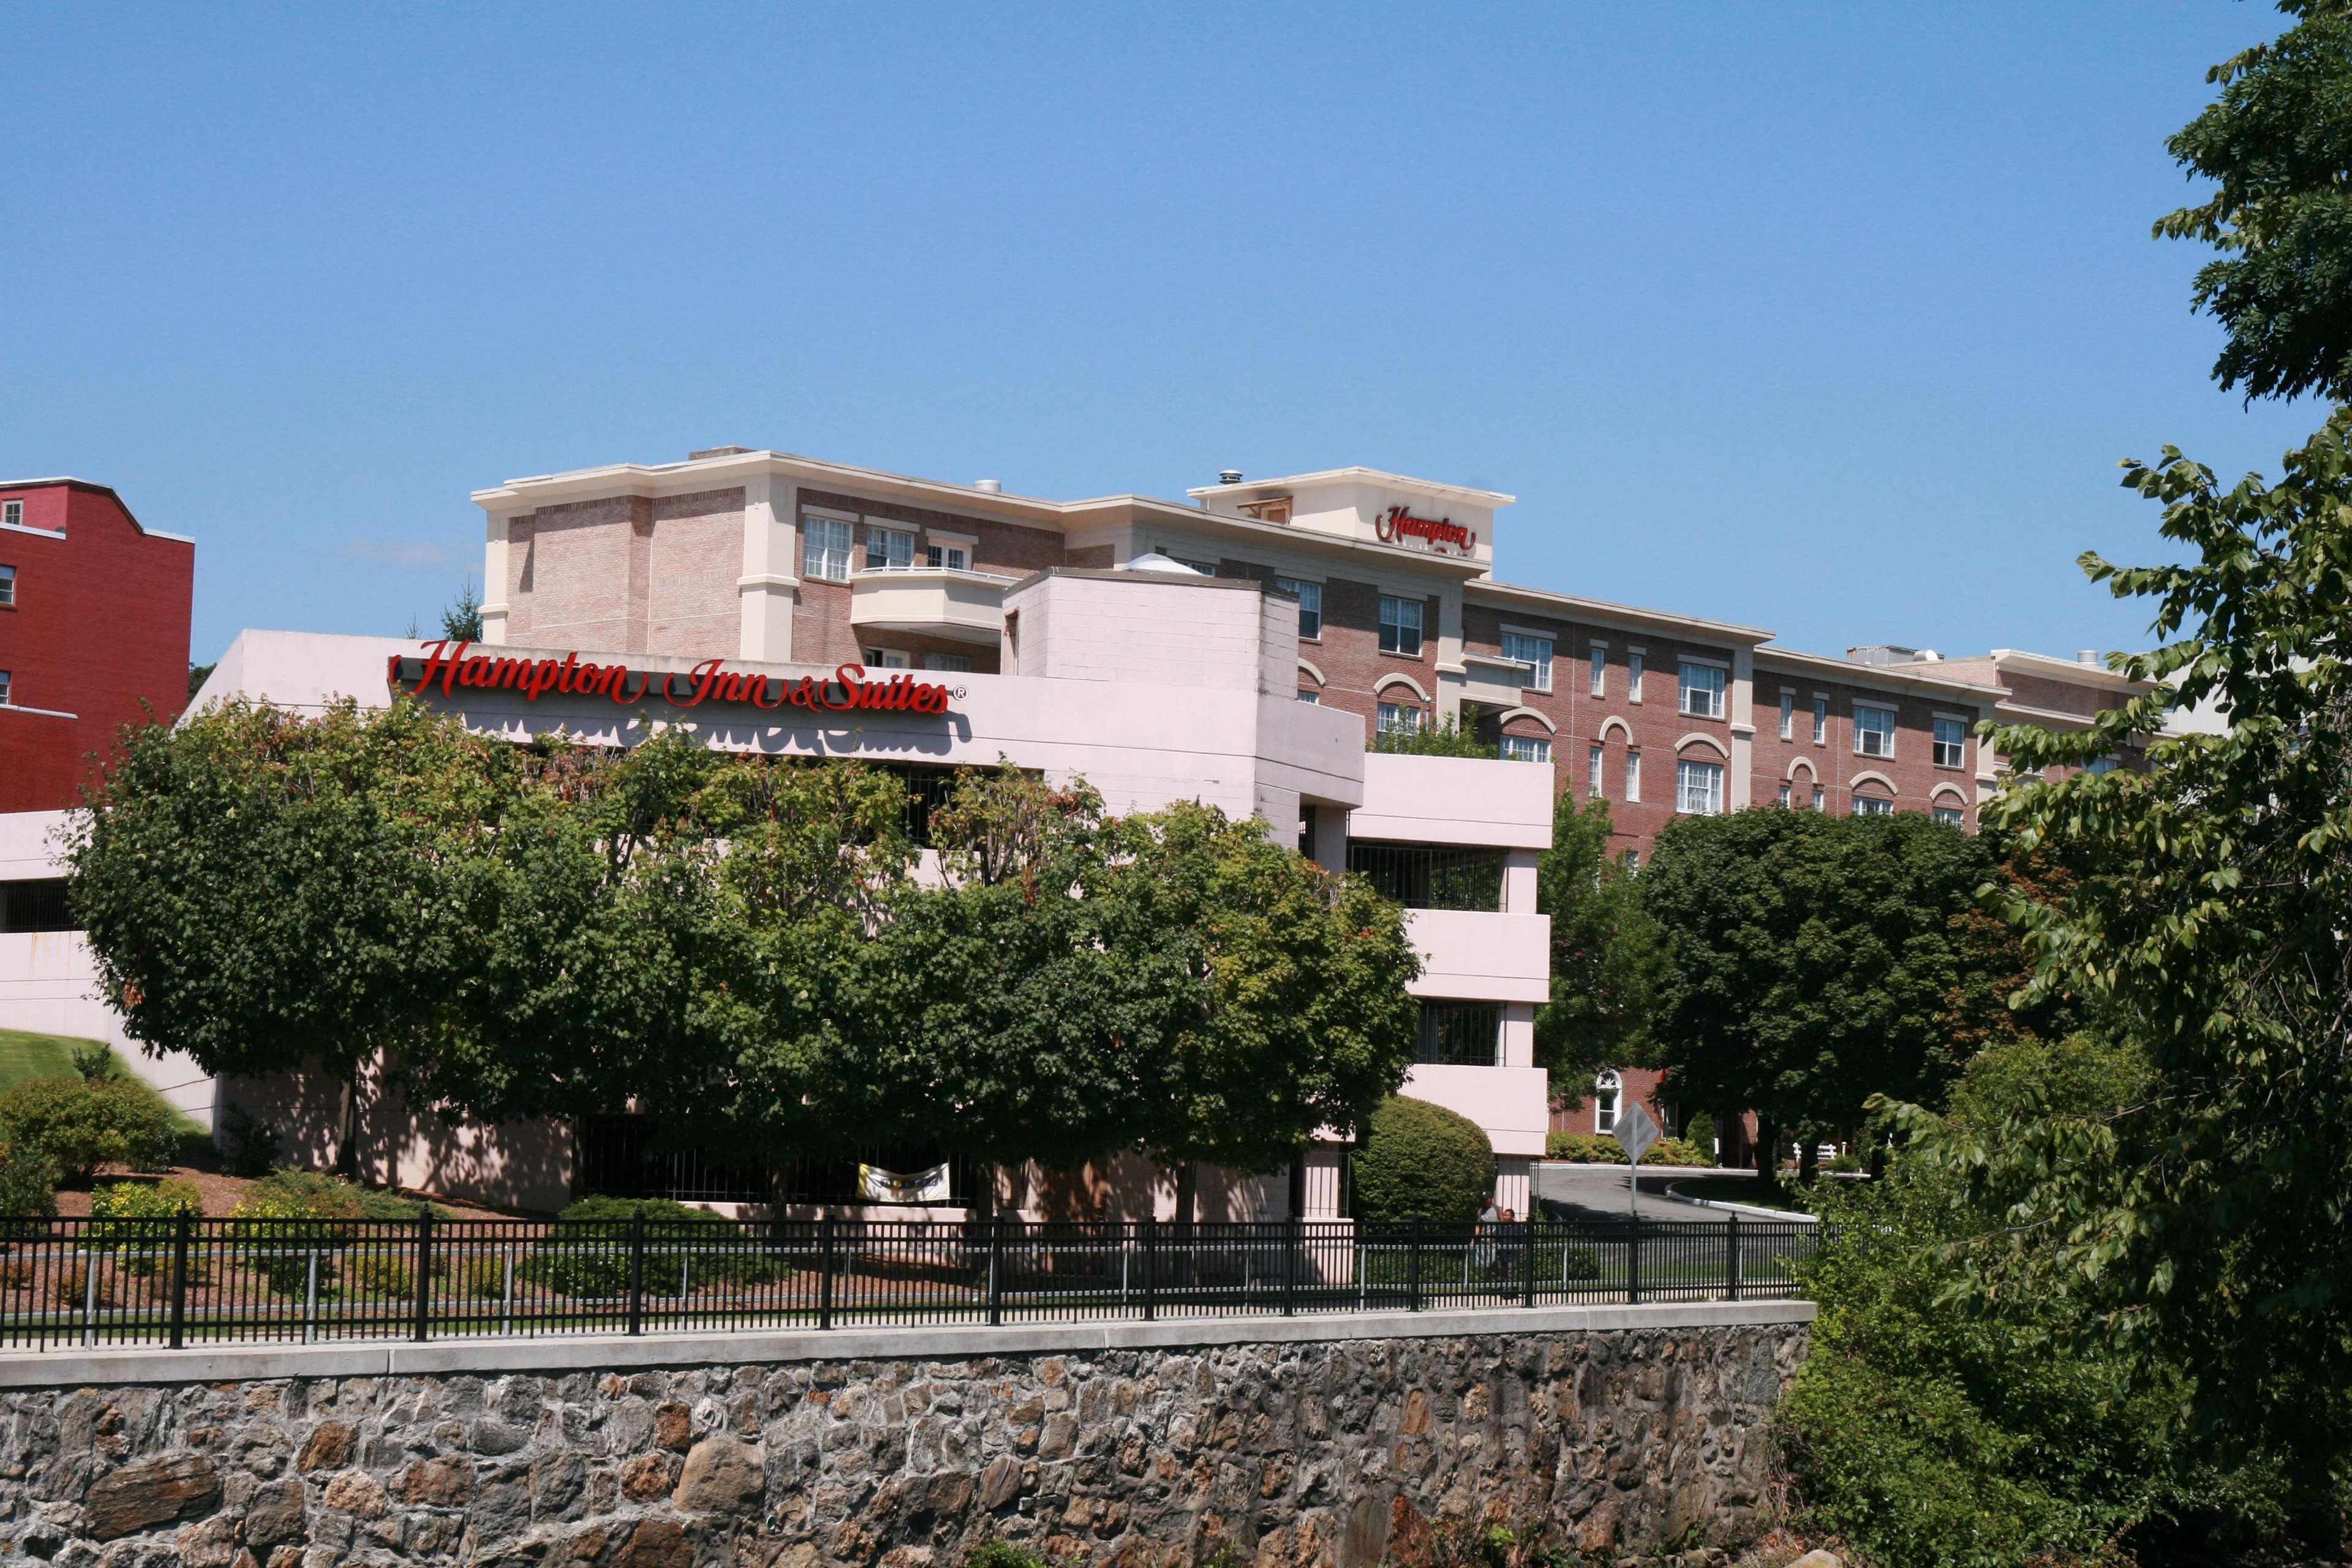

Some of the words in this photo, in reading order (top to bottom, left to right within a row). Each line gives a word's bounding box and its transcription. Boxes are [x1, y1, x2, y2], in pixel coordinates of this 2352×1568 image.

[1375, 507, 1476, 550] Hampton
[388, 639, 649, 705] Hampton
[662, 658, 790, 709] Inn
[790, 676, 822, 712] &
